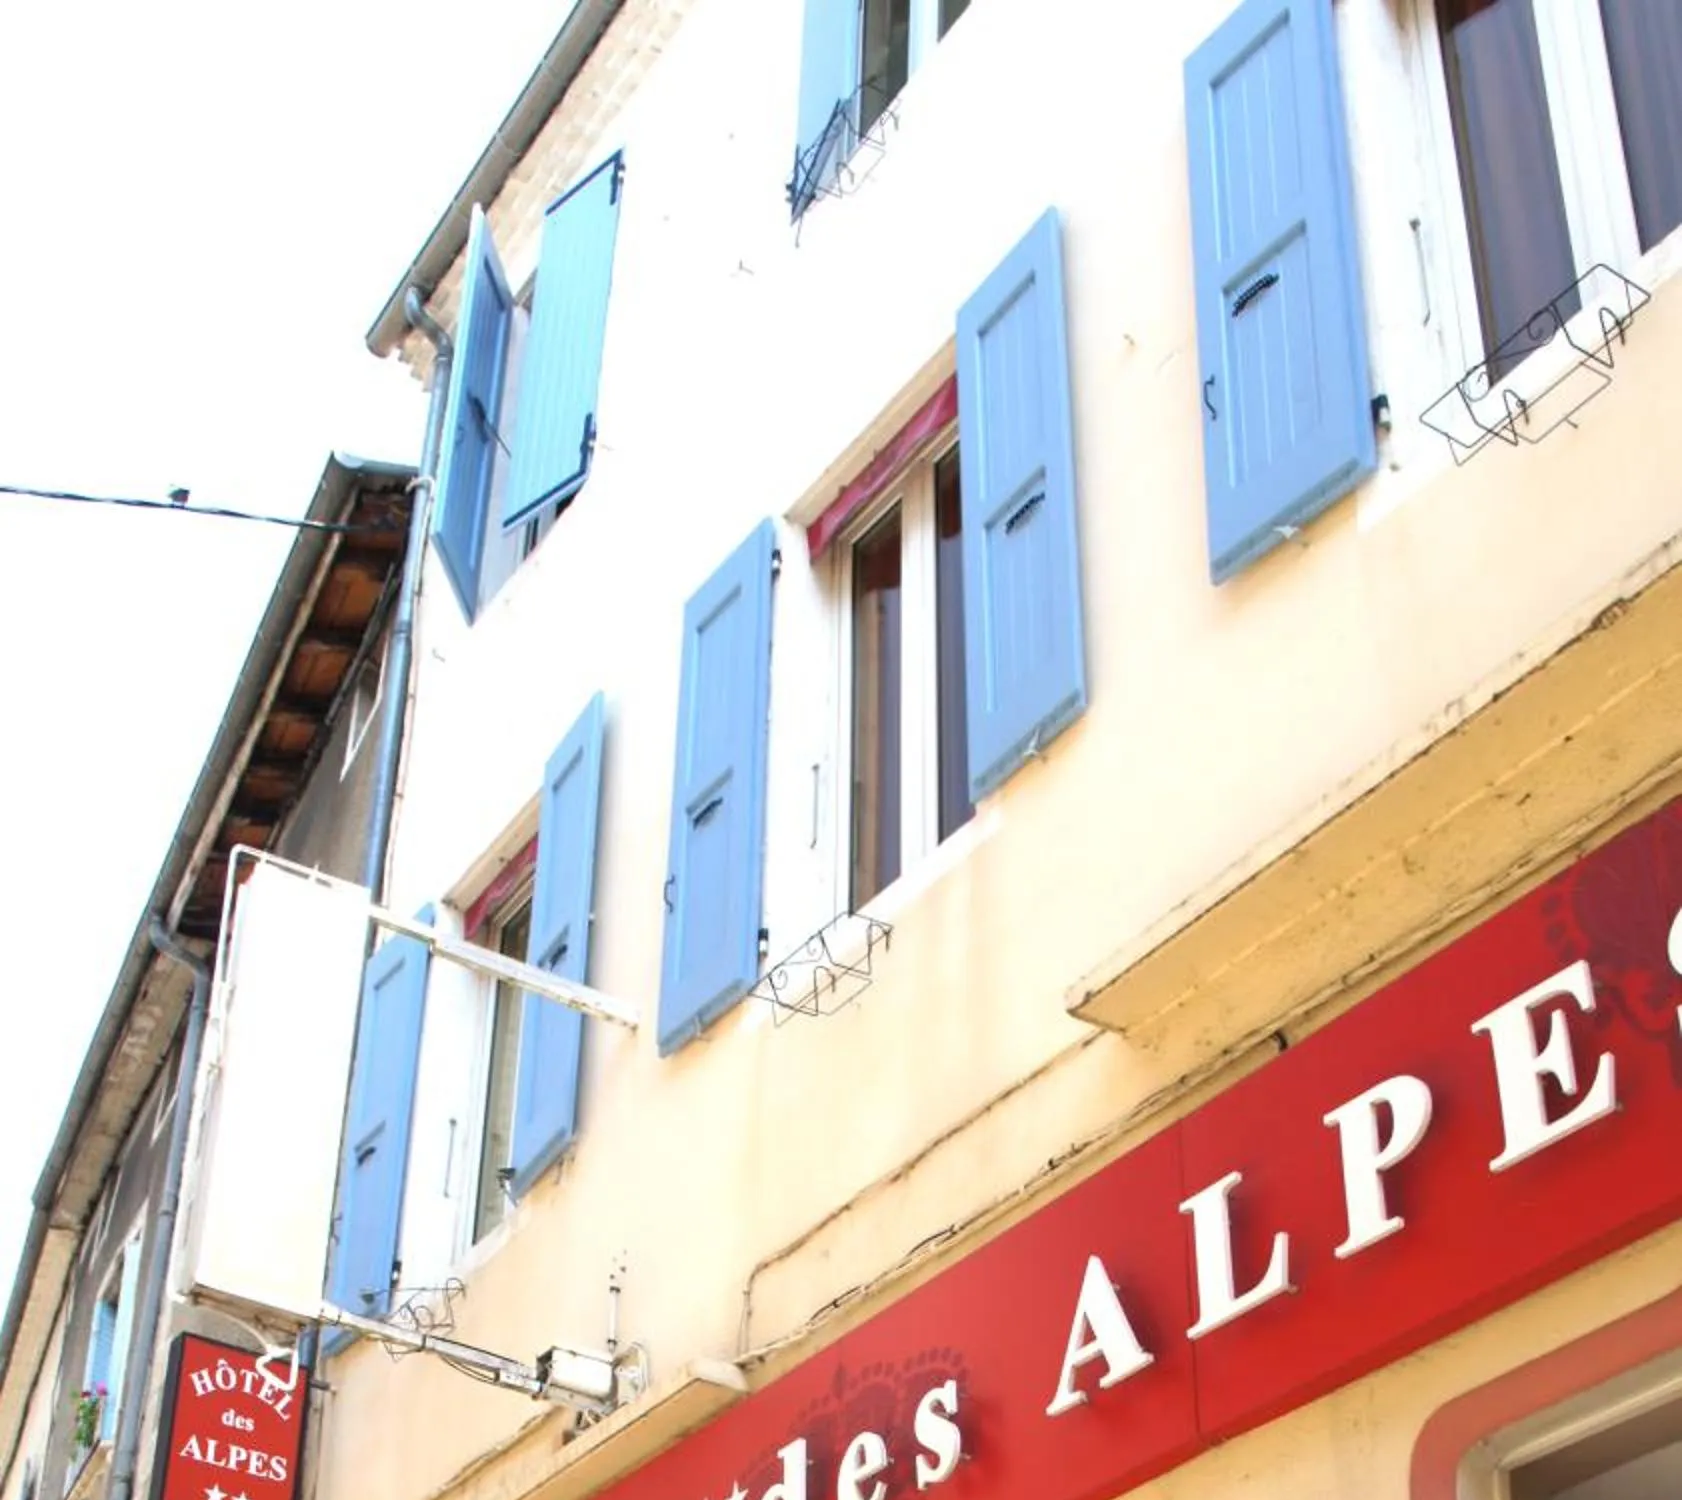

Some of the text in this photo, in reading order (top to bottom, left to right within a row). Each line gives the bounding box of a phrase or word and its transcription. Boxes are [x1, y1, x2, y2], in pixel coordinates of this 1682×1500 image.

[1046, 907, 1682, 1416] ALPE
[190, 1358, 293, 1421] HÔTEL
[221, 1409, 255, 1432] des
[179, 1433, 288, 1482] ALPES
